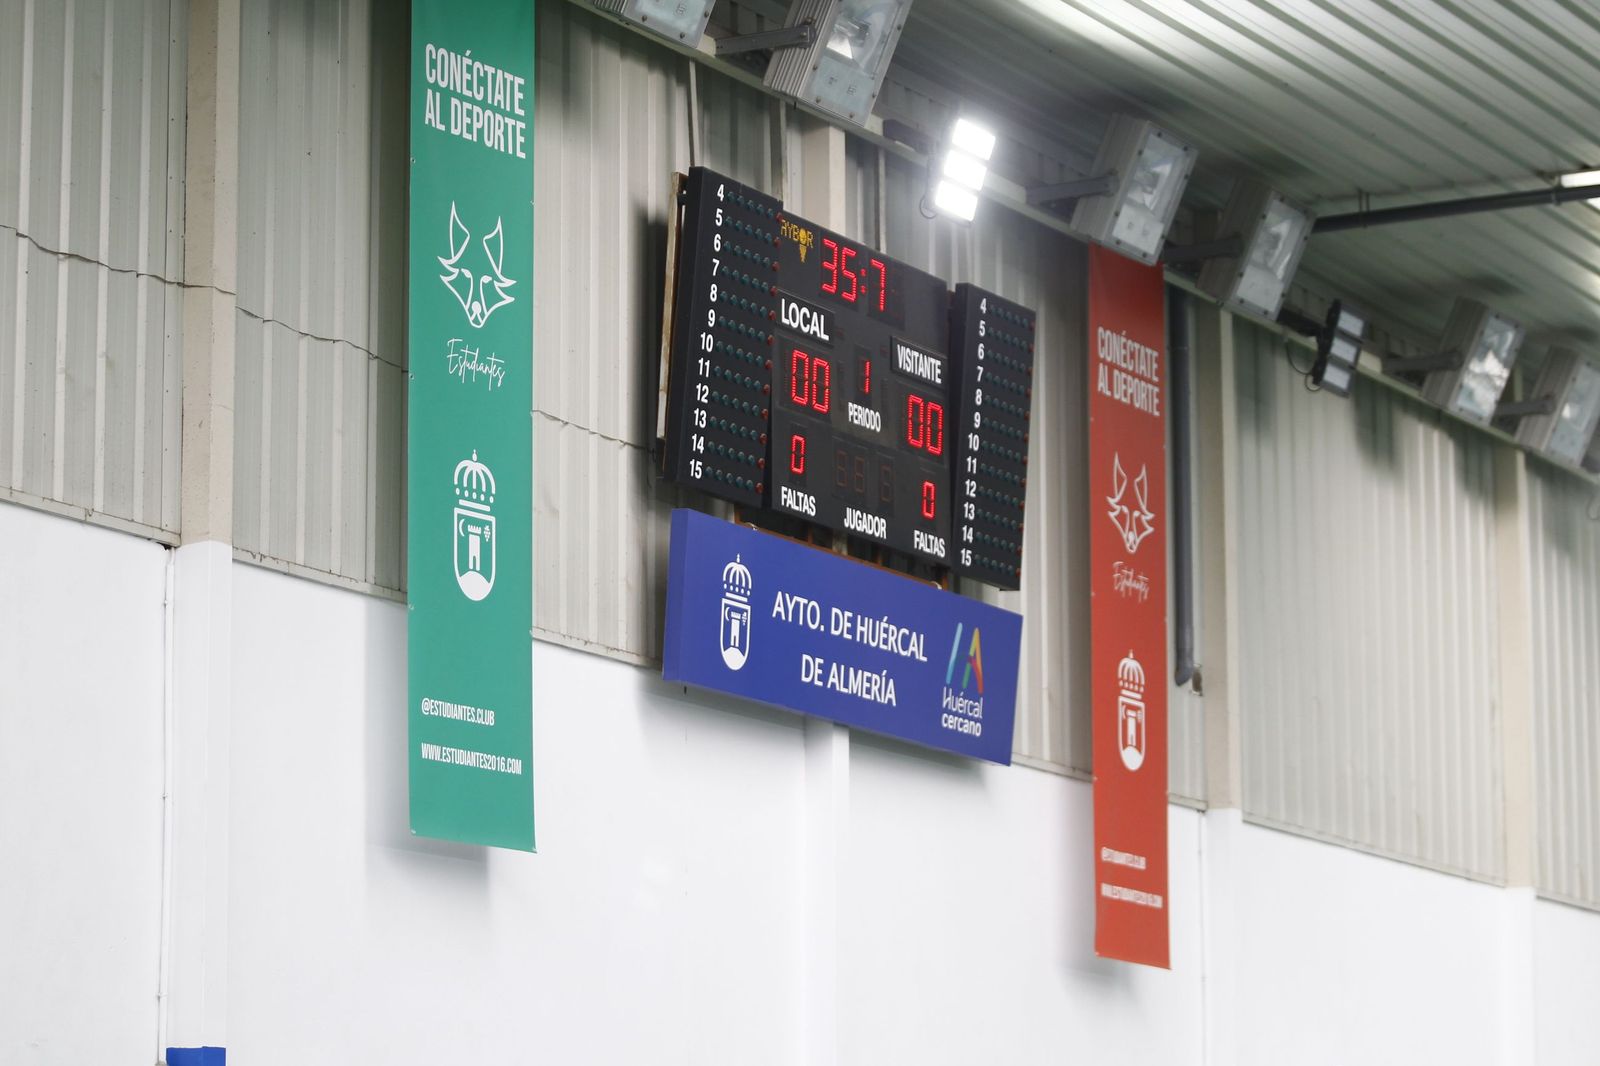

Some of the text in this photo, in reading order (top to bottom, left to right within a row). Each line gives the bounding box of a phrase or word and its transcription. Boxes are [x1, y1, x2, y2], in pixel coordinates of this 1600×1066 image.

[425, 43, 525, 117] CONÉCTATE
[424, 88, 526, 159] AL DEPORTE
[717, 184, 725, 202] 4
[715, 208, 723, 227] 5
[713, 233, 722, 252] 6
[712, 258, 720, 276] 7
[709, 283, 718, 302] 8
[980, 298, 987, 314] 4
[707, 308, 716, 328] 9
[781, 298, 830, 341] LOCAL
[979, 320, 986, 337] 5
[700, 332, 714, 353] 10
[977, 343, 985, 360] 6
[446, 338, 506, 391] Estudiantes
[897, 344, 942, 384] VISITANTE
[1098, 326, 1159, 382] CONÉCTATE
[698, 357, 711, 378] 11
[864, 360, 871, 394] 1
[976, 365, 984, 382] 7
[791, 349, 830, 413] 00
[1098, 362, 1160, 416] AL DEPORTE
[696, 382, 709, 404] 12
[975, 388, 983, 406] 8
[693, 408, 707, 428] 13
[848, 401, 881, 432] PERIODO
[907, 394, 943, 456] 00
[973, 411, 981, 429] 9
[691, 433, 705, 454] 14
[968, 432, 980, 451] 10
[791, 434, 805, 474] 0
[966, 455, 977, 474] 11
[689, 458, 703, 479] 15
[965, 478, 977, 498] 12
[781, 486, 816, 517] FALTAS
[921, 480, 936, 519] 0
[963, 501, 975, 520] 13
[844, 507, 887, 539] JUGADOR
[913, 530, 945, 558] FALTAS
[962, 524, 974, 544] 14
[960, 547, 972, 567] 15
[772, 591, 928, 662] AYTO. DE HUÉRCAL
[801, 653, 897, 707] DE ALMERÍA
[421, 697, 495, 726] @ESTUDIANTES.CLUB
[942, 686, 984, 719] Huércal
[941, 712, 982, 737] cercano
[421, 742, 522, 775] WWW.ESTUDIANTES2016.COM
